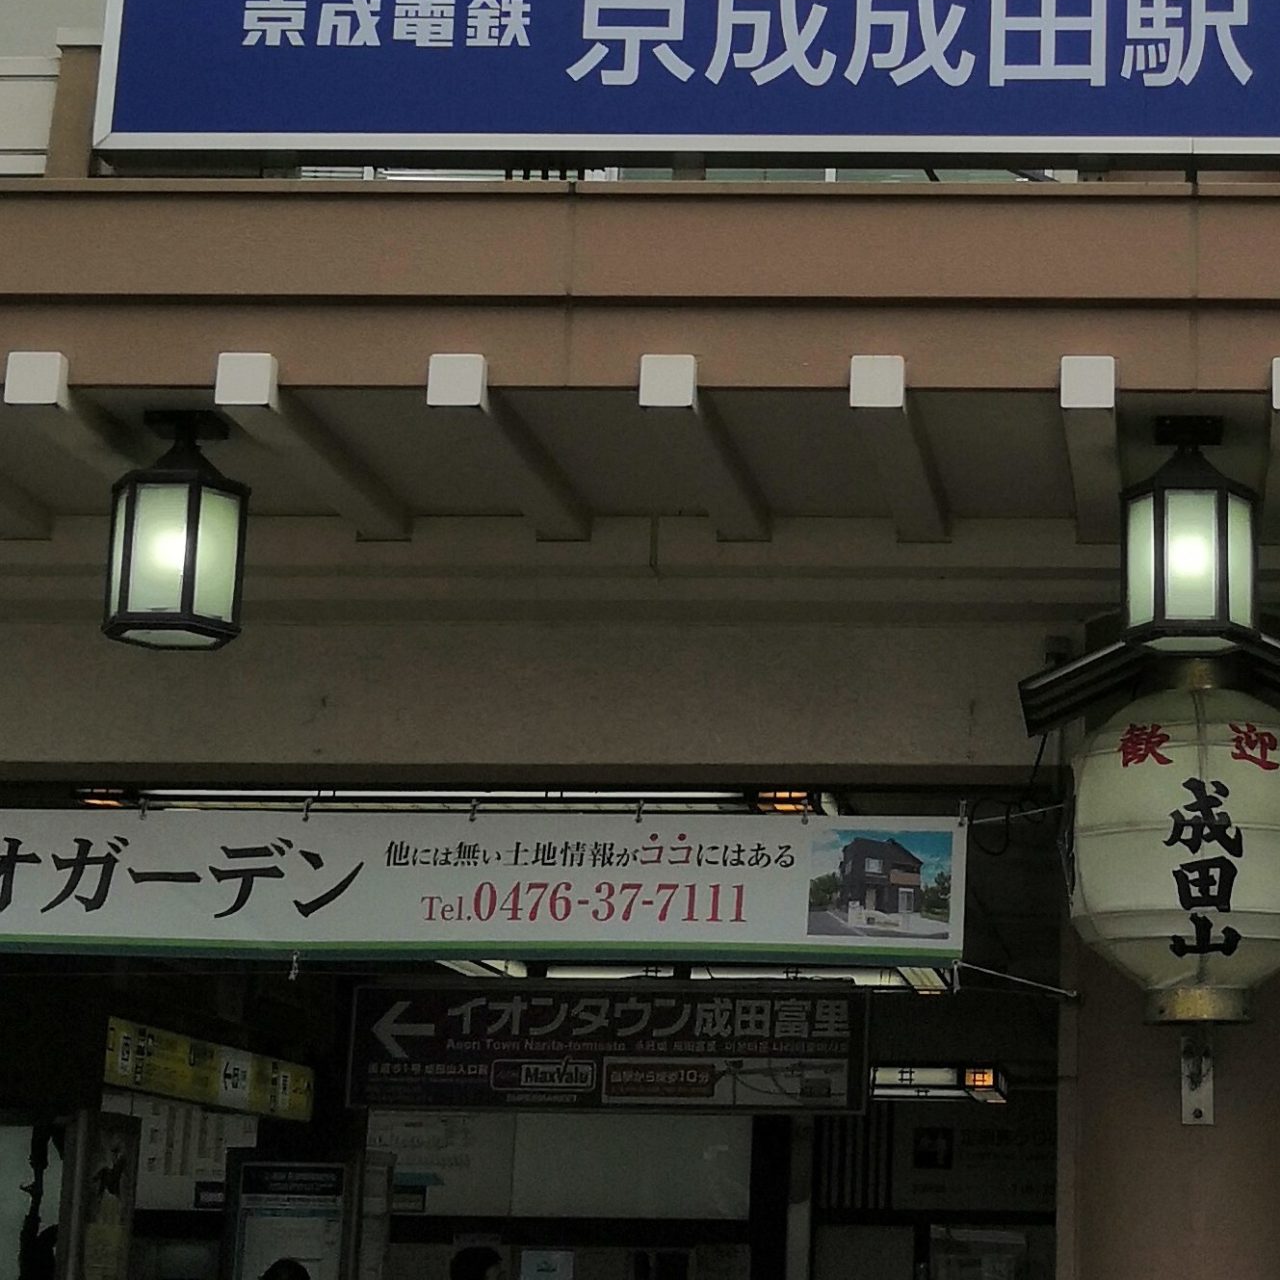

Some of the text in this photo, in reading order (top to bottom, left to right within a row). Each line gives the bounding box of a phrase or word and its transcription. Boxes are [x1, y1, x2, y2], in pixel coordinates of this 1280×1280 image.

[1117, 722, 1280, 770] 歓迎
[1161, 776, 1244, 958] 成田山
[445, 995, 851, 1039] イオンタウン成田富里
[486, 1038, 520, 1051] Town
